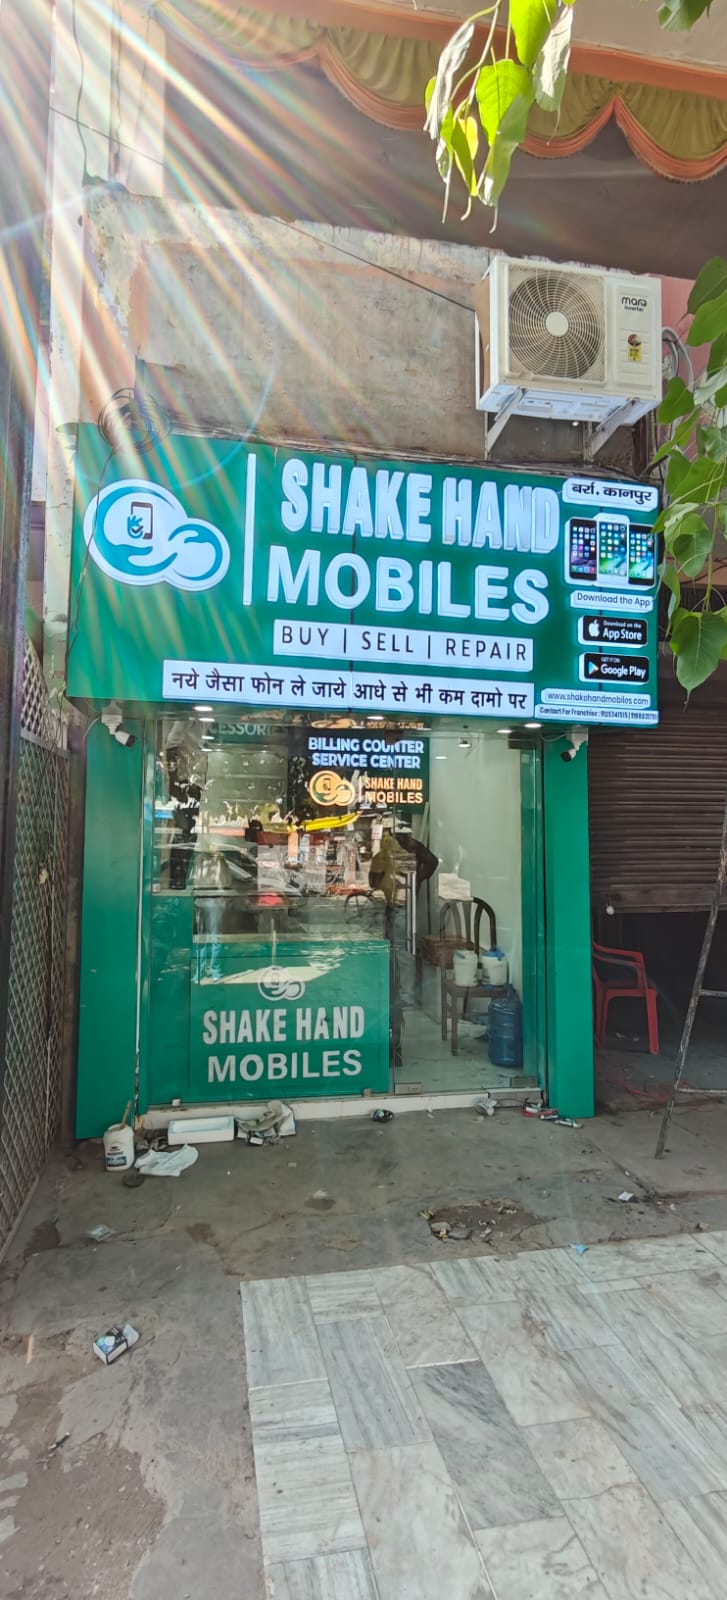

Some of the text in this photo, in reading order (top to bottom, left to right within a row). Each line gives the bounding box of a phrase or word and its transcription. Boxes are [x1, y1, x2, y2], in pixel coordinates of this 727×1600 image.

[603, 487, 652, 504] कानपुर
[281, 458, 560, 554] SHAKE HAND
[267, 545, 550, 625] MOBILES
[577, 592, 651, 608] Download the App
[603, 627, 642, 640] App Store
[281, 625, 329, 647] BUY
[361, 631, 415, 653] SELL
[446, 638, 526, 661] REPAIR
[601, 664, 646, 679] Google Play
[171, 668, 527, 709] नये जैसा फोन ले जाये आधे से भी कम दामो पर
[540, 707, 561, 715] Contact
[308, 737, 424, 754] BILLING COUNTER
[312, 753, 421, 769] SERVICE CENTER
[365, 776, 423, 790] SHAKE HAND
[365, 791, 424, 804] MOBILES
[202, 1006, 365, 1045] SHAKE HAND
[207, 1049, 363, 1083] MOBILES
